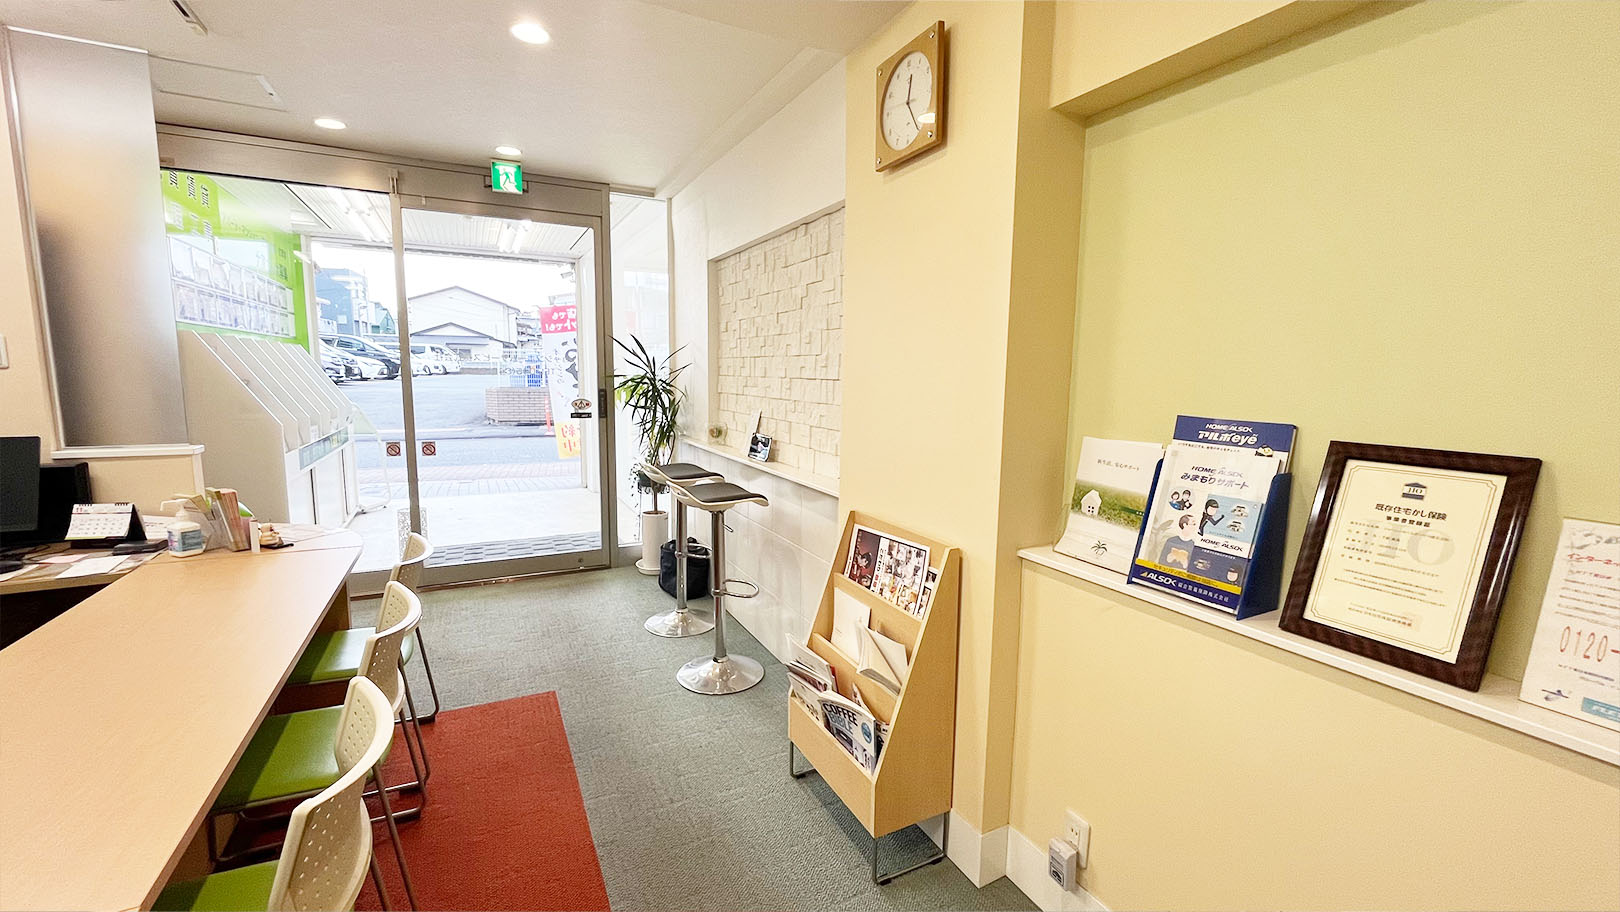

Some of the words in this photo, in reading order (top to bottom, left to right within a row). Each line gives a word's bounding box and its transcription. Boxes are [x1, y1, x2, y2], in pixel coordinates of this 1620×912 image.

[1205, 423, 1228, 431] HOME
[1229, 424, 1253, 433] ALSOK
[1191, 465, 1217, 475] HOME
[1180, 472, 1249, 489] みまもりサポート
[1375, 503, 1448, 521] 既存住宅かし保険
[1200, 538, 1221, 547] HOME
[1147, 572, 1177, 587] ALSOK
[1560, 626, 1620, 662] 0120-
[822, 703, 859, 726] COFFEE
[828, 712, 854, 735] BIBLE
